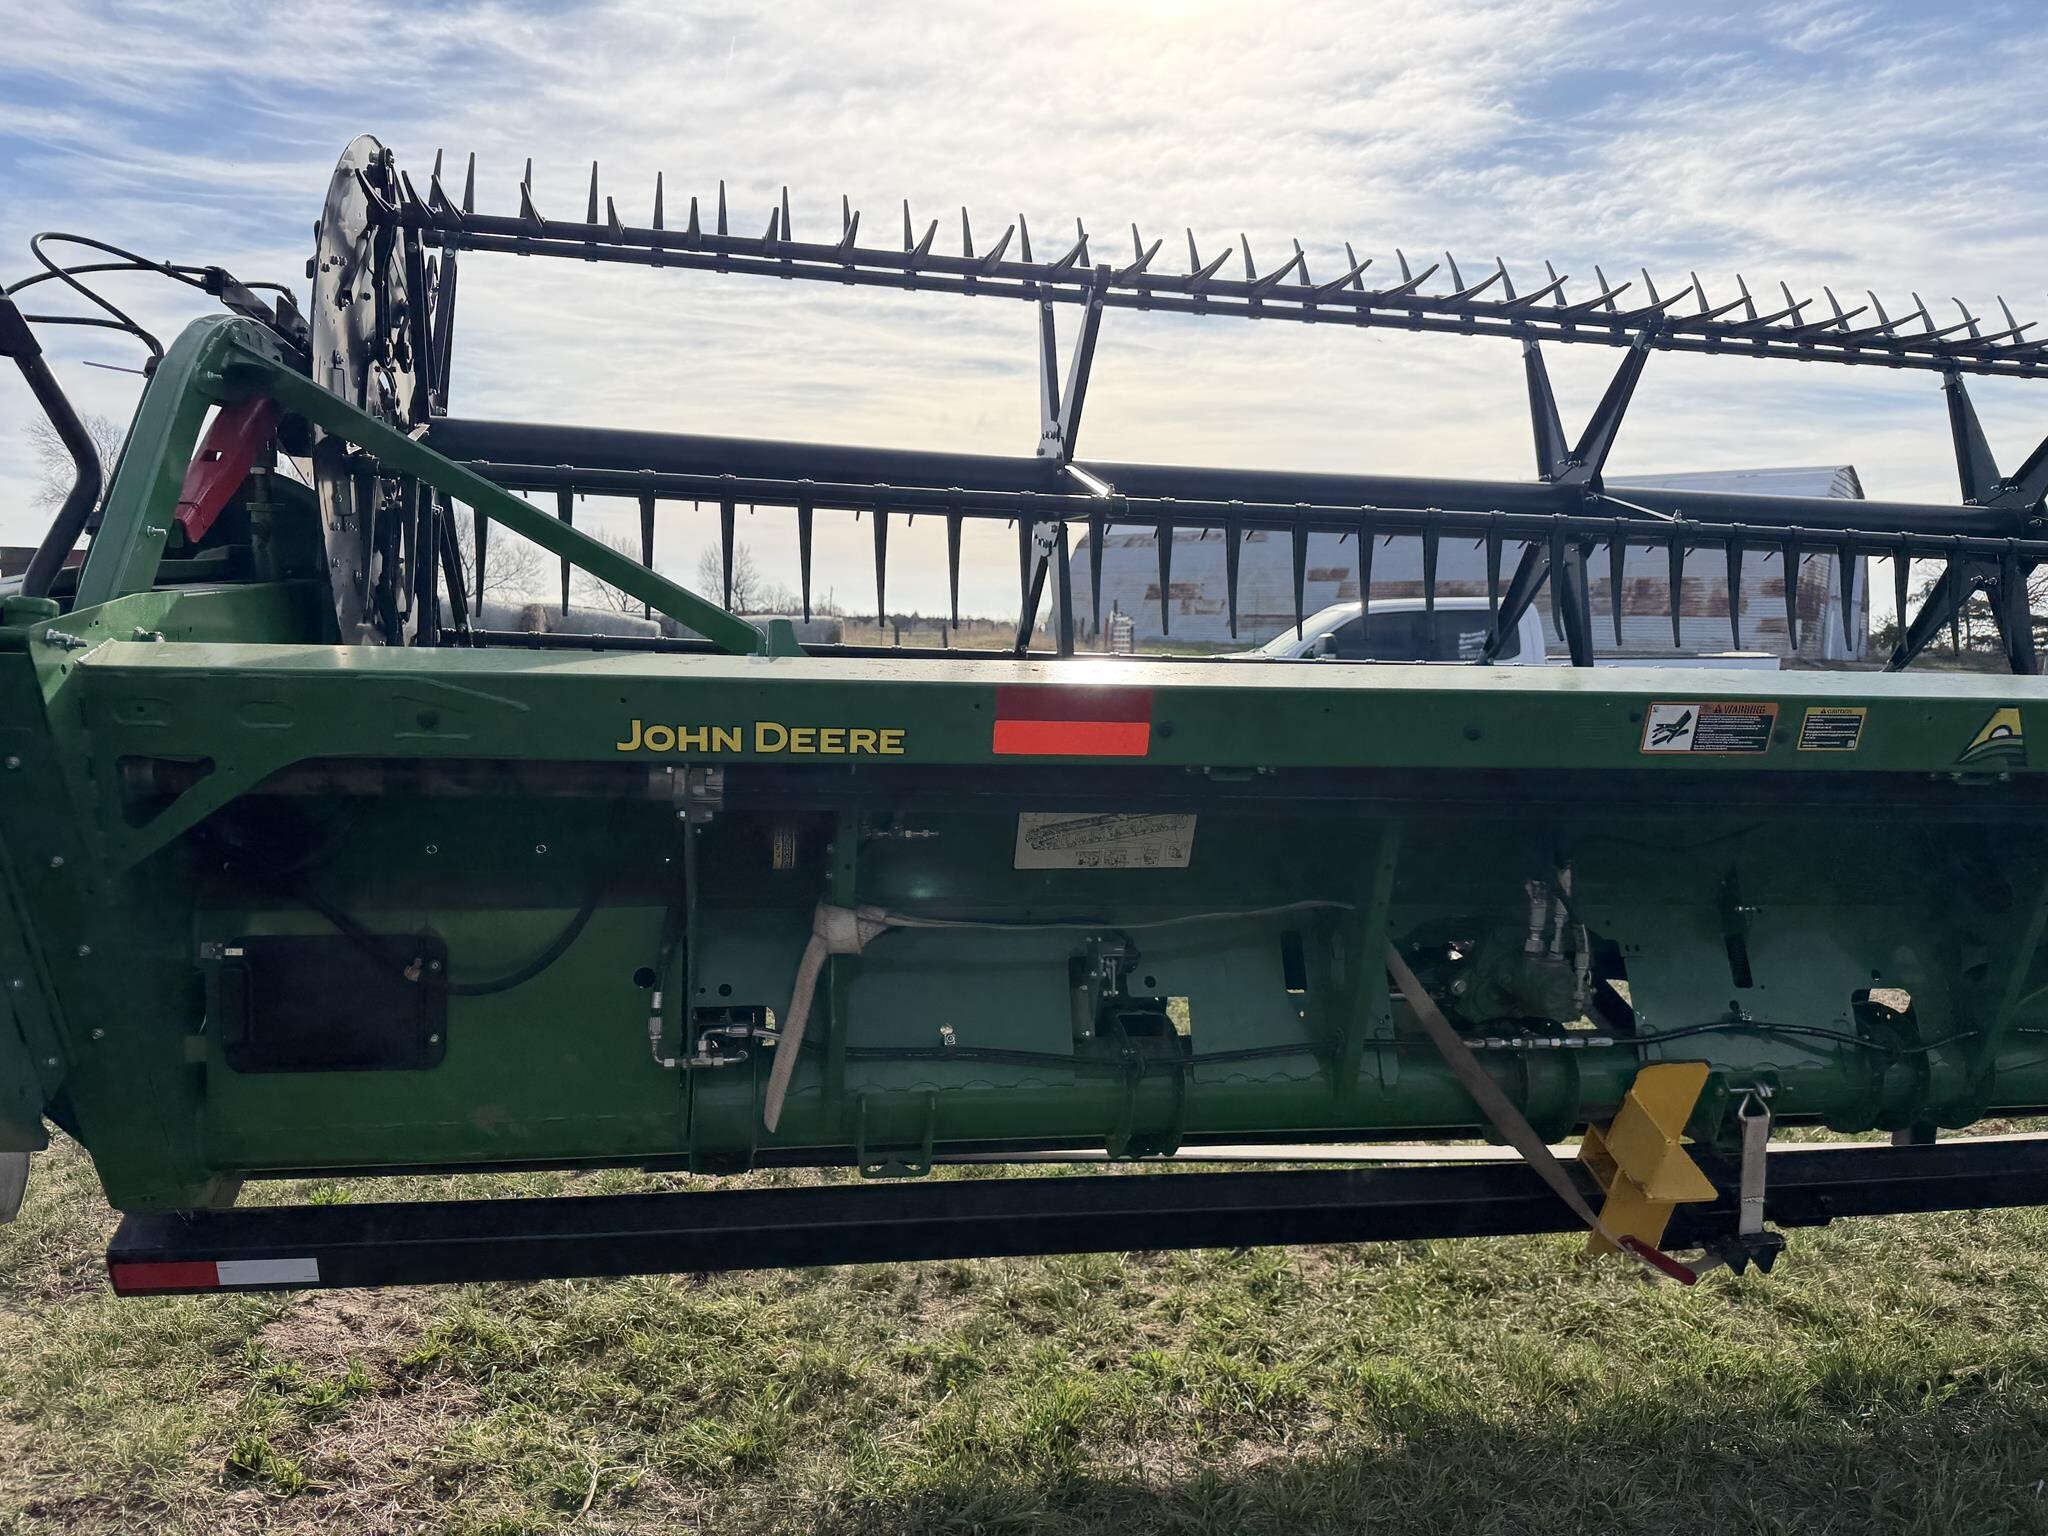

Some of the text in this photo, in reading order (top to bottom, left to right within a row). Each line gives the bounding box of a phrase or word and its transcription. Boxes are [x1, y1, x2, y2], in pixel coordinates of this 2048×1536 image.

[1724, 705, 1766, 714] WARNING
[616, 719, 906, 754] JOHN DEERE
